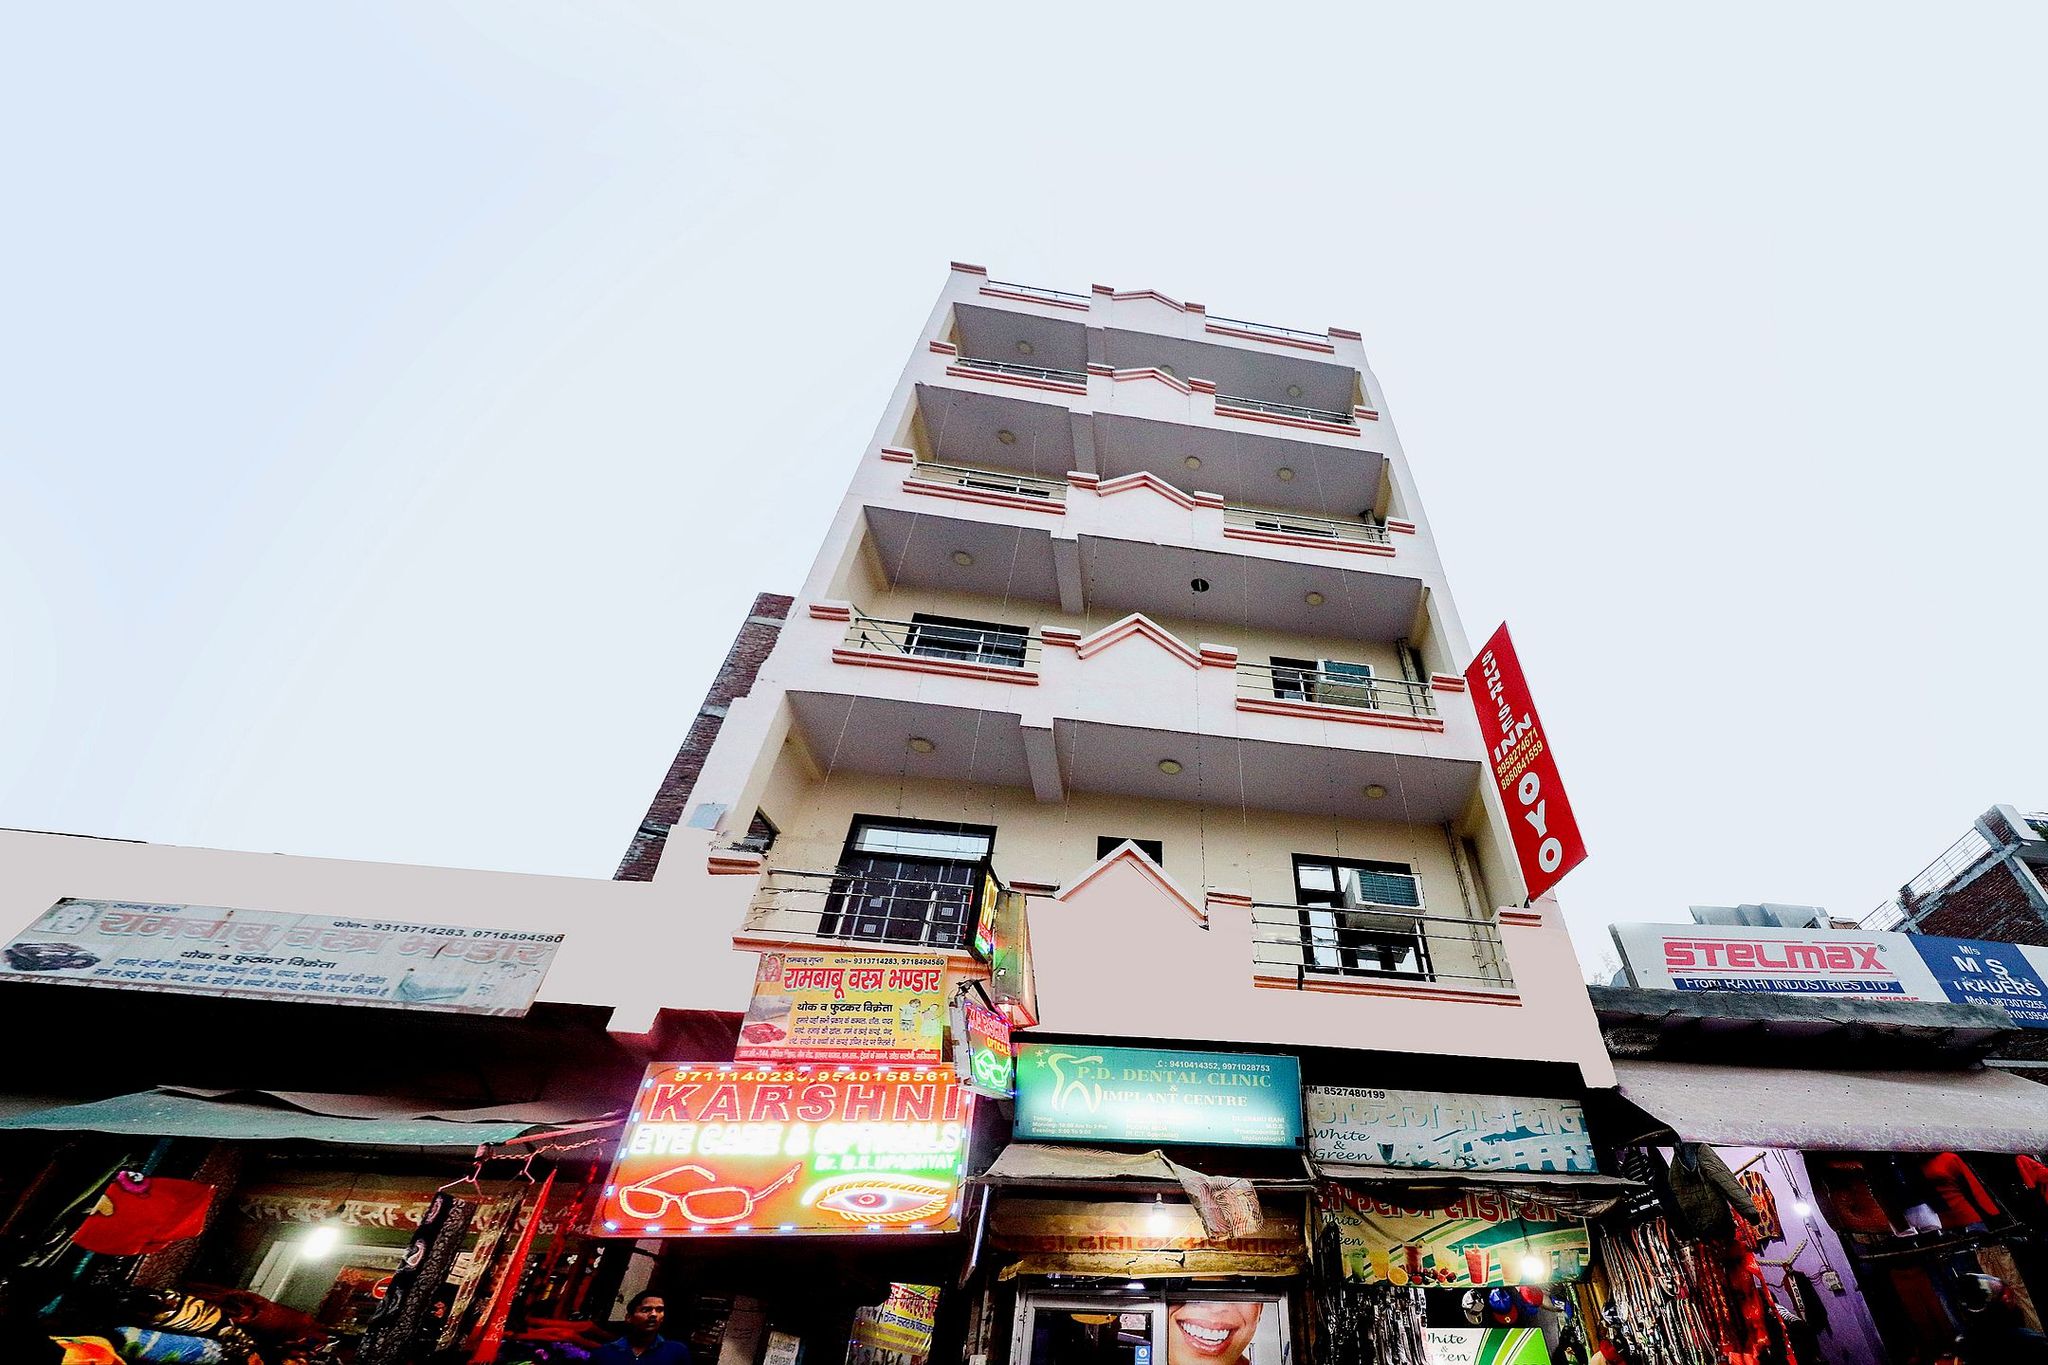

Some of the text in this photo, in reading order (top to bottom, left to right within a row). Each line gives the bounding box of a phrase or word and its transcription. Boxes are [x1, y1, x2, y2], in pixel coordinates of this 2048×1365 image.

[1494, 712, 1532, 762] INN
[1518, 771, 1562, 873] OYO
[1952, 956, 2008, 976] M S
[784, 967, 942, 999] रामबाबू वस्त्र भण्डार
[1773, 979, 1861, 992] INDUSTRIES
[797, 1001, 817, 1012] थोक
[820, 1003, 827, 1012] व
[863, 1001, 893, 1012] विक्रेता
[1169, 1060, 1271, 1072] 9410414352, 9971028753
[1078, 1066, 1272, 1088] P.D. DENTAL CLINIC
[1323, 1086, 1386, 1099] 8527480199
[647, 1083, 961, 1123] KARSHNI
[1183, 1093, 1248, 1107] CENTRE
[1312, 1128, 1370, 1141] White
[1333, 1140, 1347, 1150] &
[1313, 1148, 1373, 1160] Green
